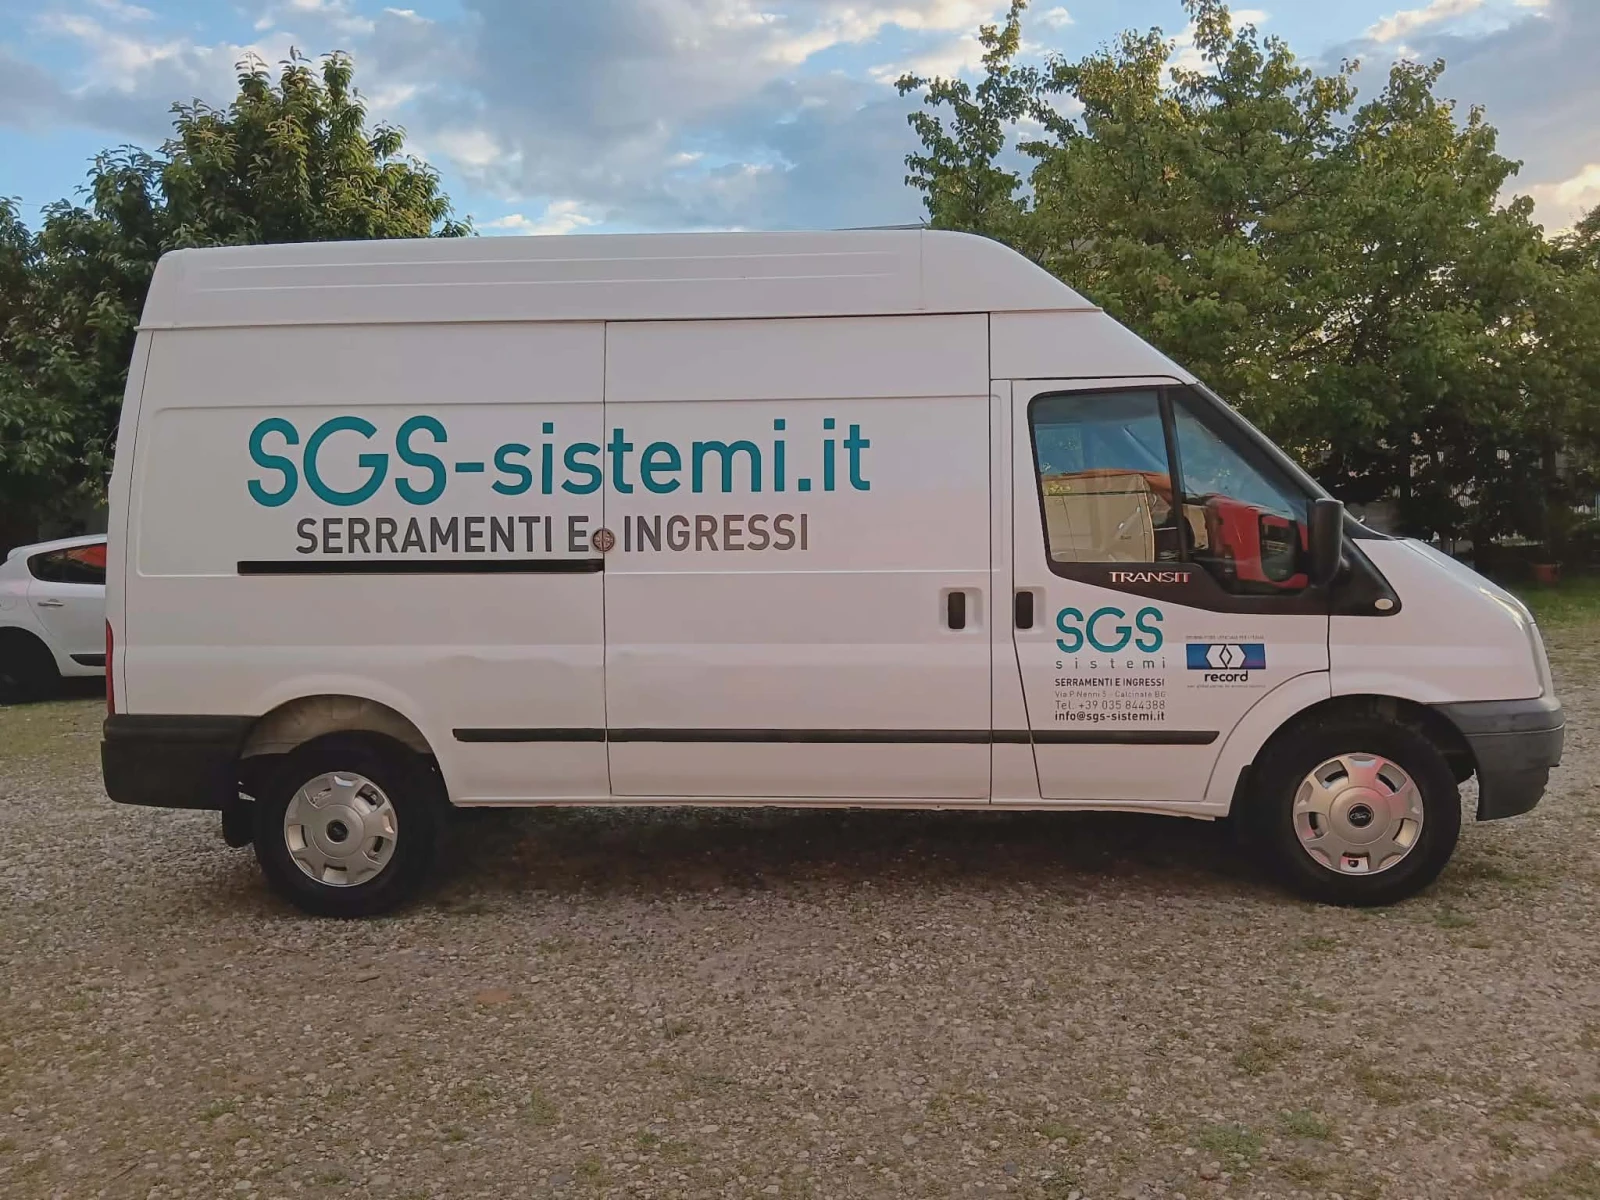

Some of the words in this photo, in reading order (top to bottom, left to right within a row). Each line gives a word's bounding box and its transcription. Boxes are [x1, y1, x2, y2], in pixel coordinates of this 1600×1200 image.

[247, 415, 871, 507] SGS-sistemi.it
[296, 515, 552, 554] SERRAMENTI
[569, 515, 589, 552] E
[624, 513, 809, 552] INGRESSI
[1108, 571, 1192, 583] TRANSIT
[1056, 607, 1164, 653] SGS
[1056, 657, 1166, 669] sistemi
[1204, 670, 1248, 682] record
[1055, 678, 1113, 687] SERRAMENTI
[1115, 678, 1121, 687] E
[1123, 678, 1165, 687] INGRESSI
[1055, 700, 1074, 710] Tel.
[1079, 700, 1098, 710] +39
[1102, 700, 1121, 710] 035
[1125, 700, 1166, 710] 844388
[1055, 711, 1165, 723] info@sgs-sistemi.it
